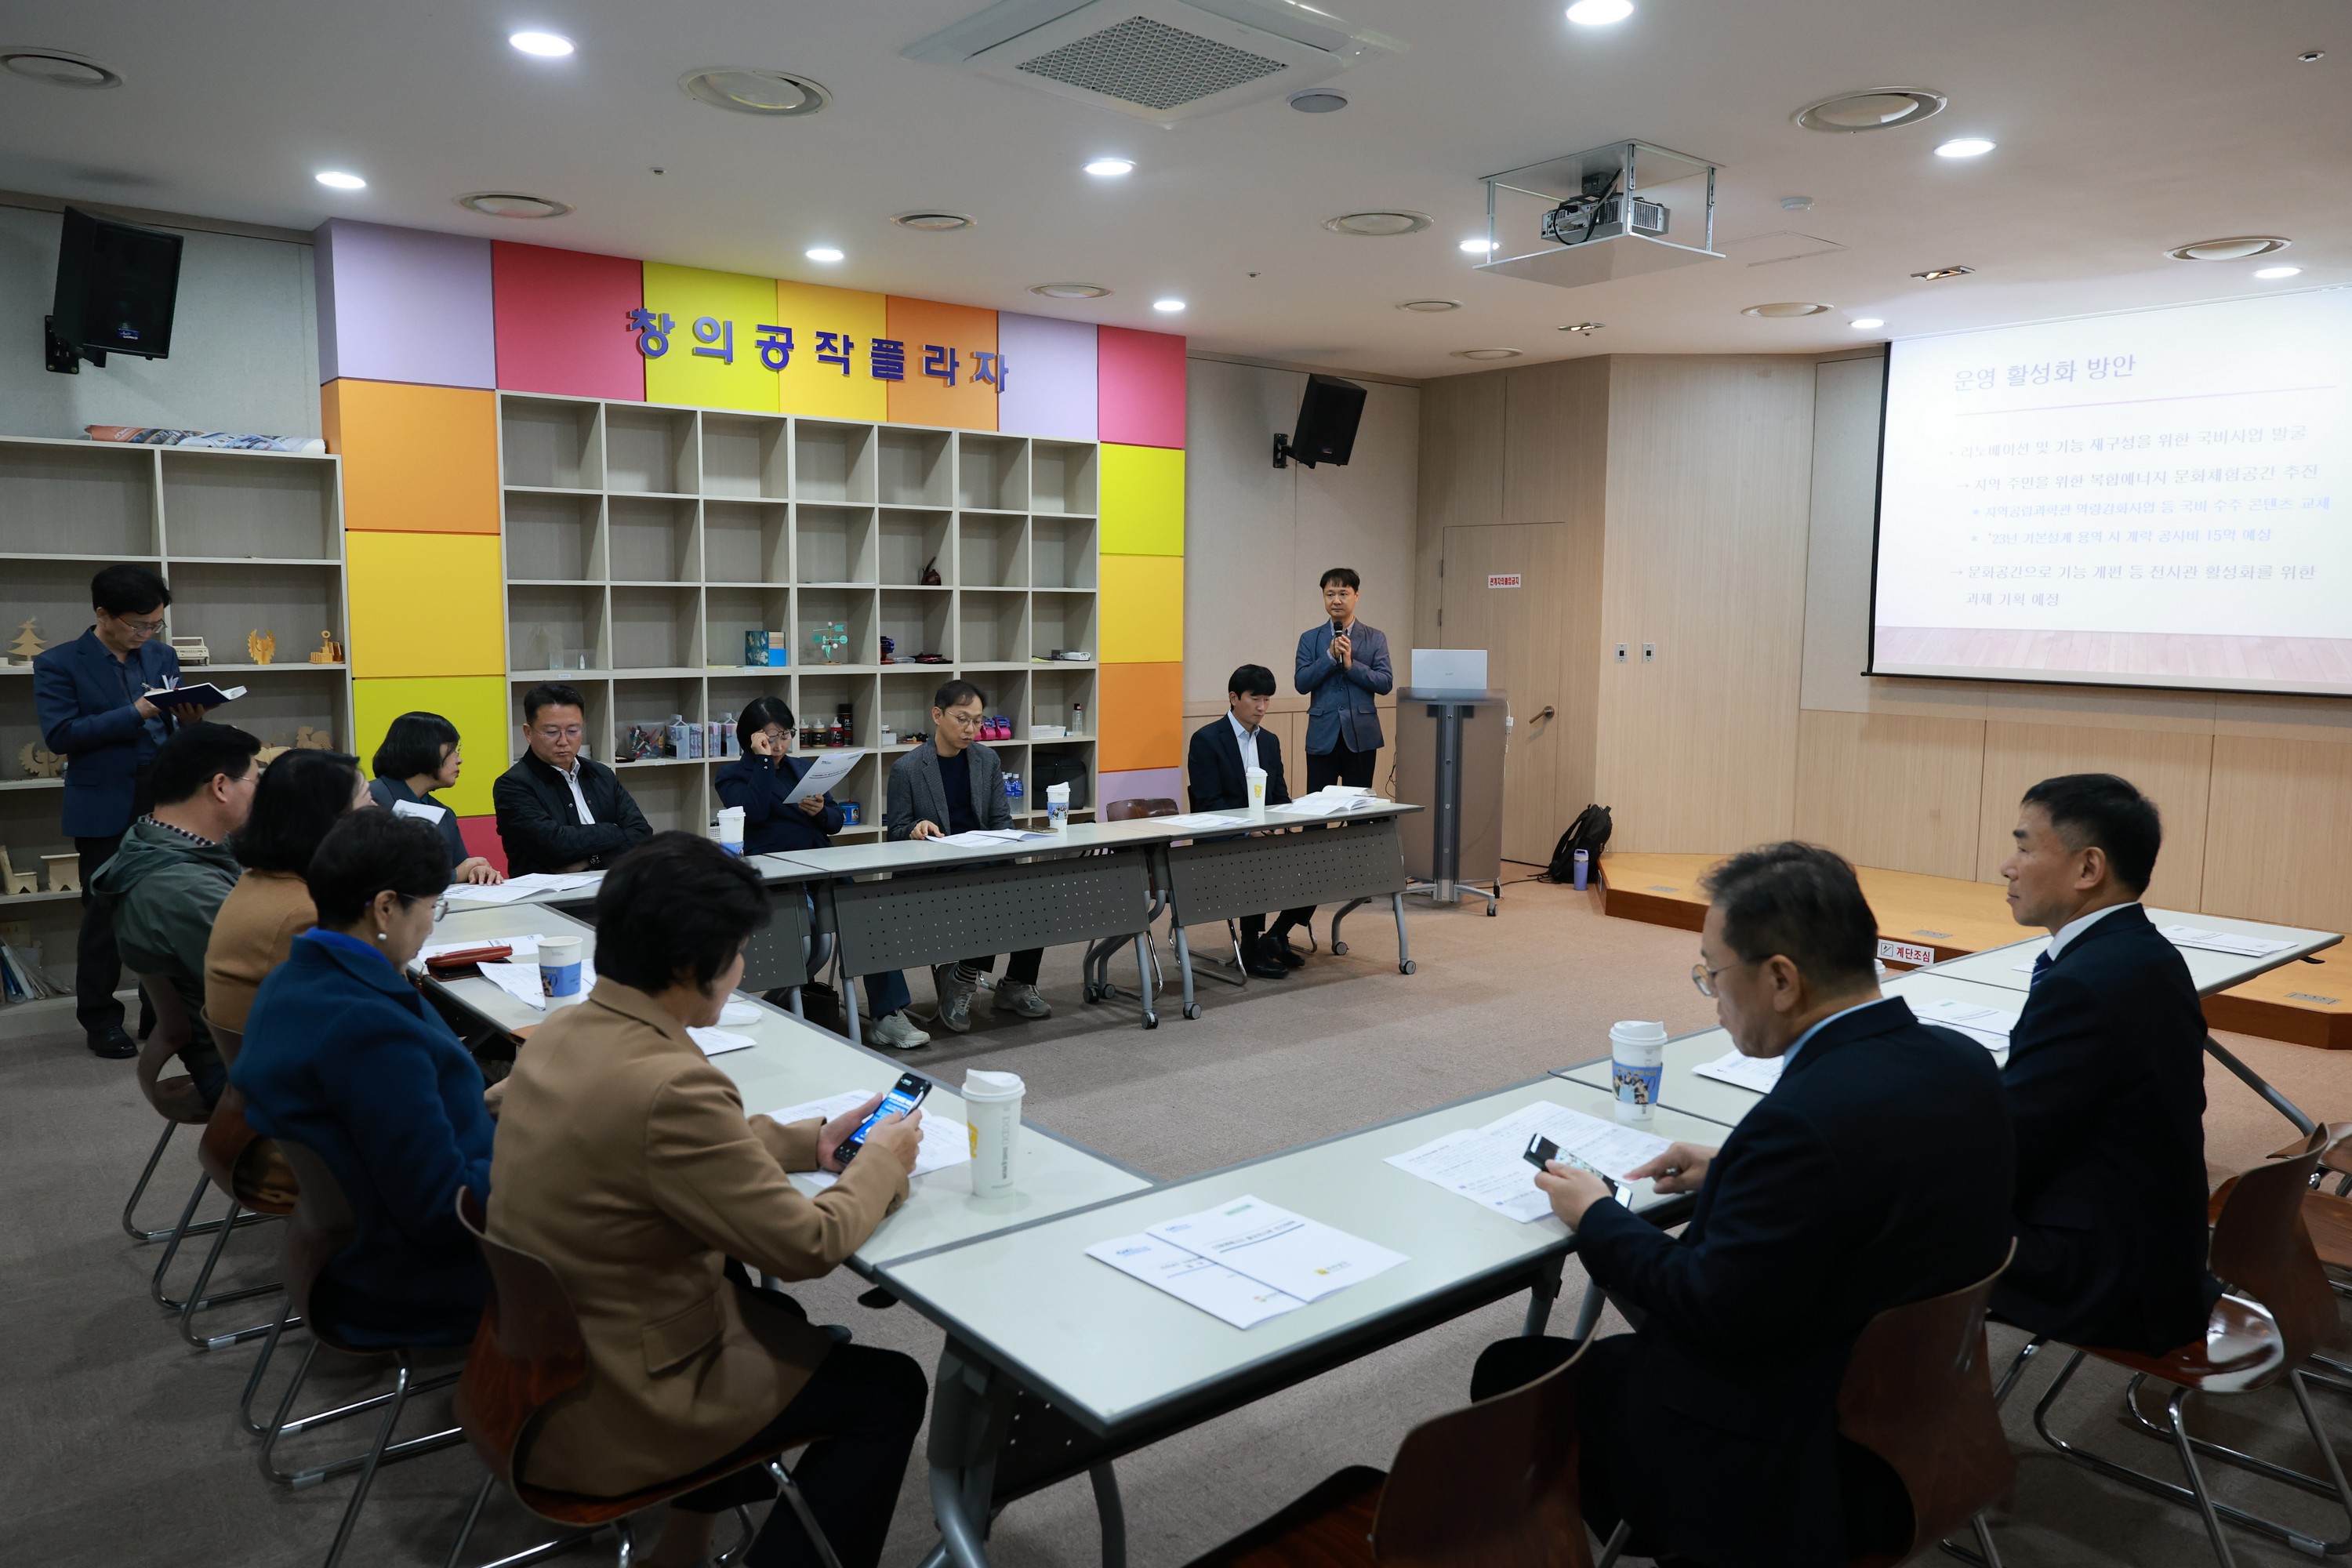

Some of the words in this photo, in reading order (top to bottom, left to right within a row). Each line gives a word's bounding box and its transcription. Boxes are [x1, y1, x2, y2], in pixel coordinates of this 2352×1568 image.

[628, 307, 1009, 393] 창의공작플라자
[1954, 367, 1995, 392] 운영
[2006, 359, 2078, 387] 활성화
[2087, 354, 2136, 380] 방안
[1961, 441, 2030, 459] 리노베이션
[2035, 440, 2049, 455] 및
[2056, 438, 2084, 454] 기능
[2089, 434, 2151, 452] 재구성을
[2158, 432, 2190, 448] 위한
[2197, 427, 2263, 445] 국비사업
[2272, 425, 2307, 441] 발굴
[1974, 477, 2001, 492] 지역
[2007, 476, 2049, 491] 주민을
[2055, 474, 2084, 489] 위한
[2091, 470, 2167, 487] 복합에너지
[2174, 465, 2276, 484] 문화체험공간
[2283, 463, 2318, 481] 추진
[1984, 503, 2072, 518] 지역공립과학관
[2076, 501, 2155, 516] 역량강화사업
[2161, 500, 2175, 514] 등
[2180, 499, 2208, 513] 국비
[2213, 498, 2242, 513] 수주
[2249, 497, 2293, 511] 콘텐츠
[2299, 495, 2330, 510] 교체
[2023, 531, 2072, 545] 기본설계
[2078, 530, 2103, 544] 용역
[2107, 530, 2121, 543] 시
[2126, 530, 2154, 543] 개략
[2158, 529, 2199, 543] 공사비
[2207, 528, 2236, 542] 15억
[2242, 528, 2272, 542] 예상
[1969, 565, 2052, 579] 문화공간으로
[2057, 564, 2087, 579] 기능
[2092, 564, 2122, 580] 개편
[2129, 564, 2143, 580] 등
[2150, 564, 2198, 580] 전시관
[2205, 564, 2273, 580] 활성화를
[2280, 564, 2316, 581] 위한
[1965, 592, 1992, 606] 과제
[1998, 592, 2025, 607] 기획
[2031, 593, 2059, 607] 예정
[1896, 946, 1931, 963] 계단조심
